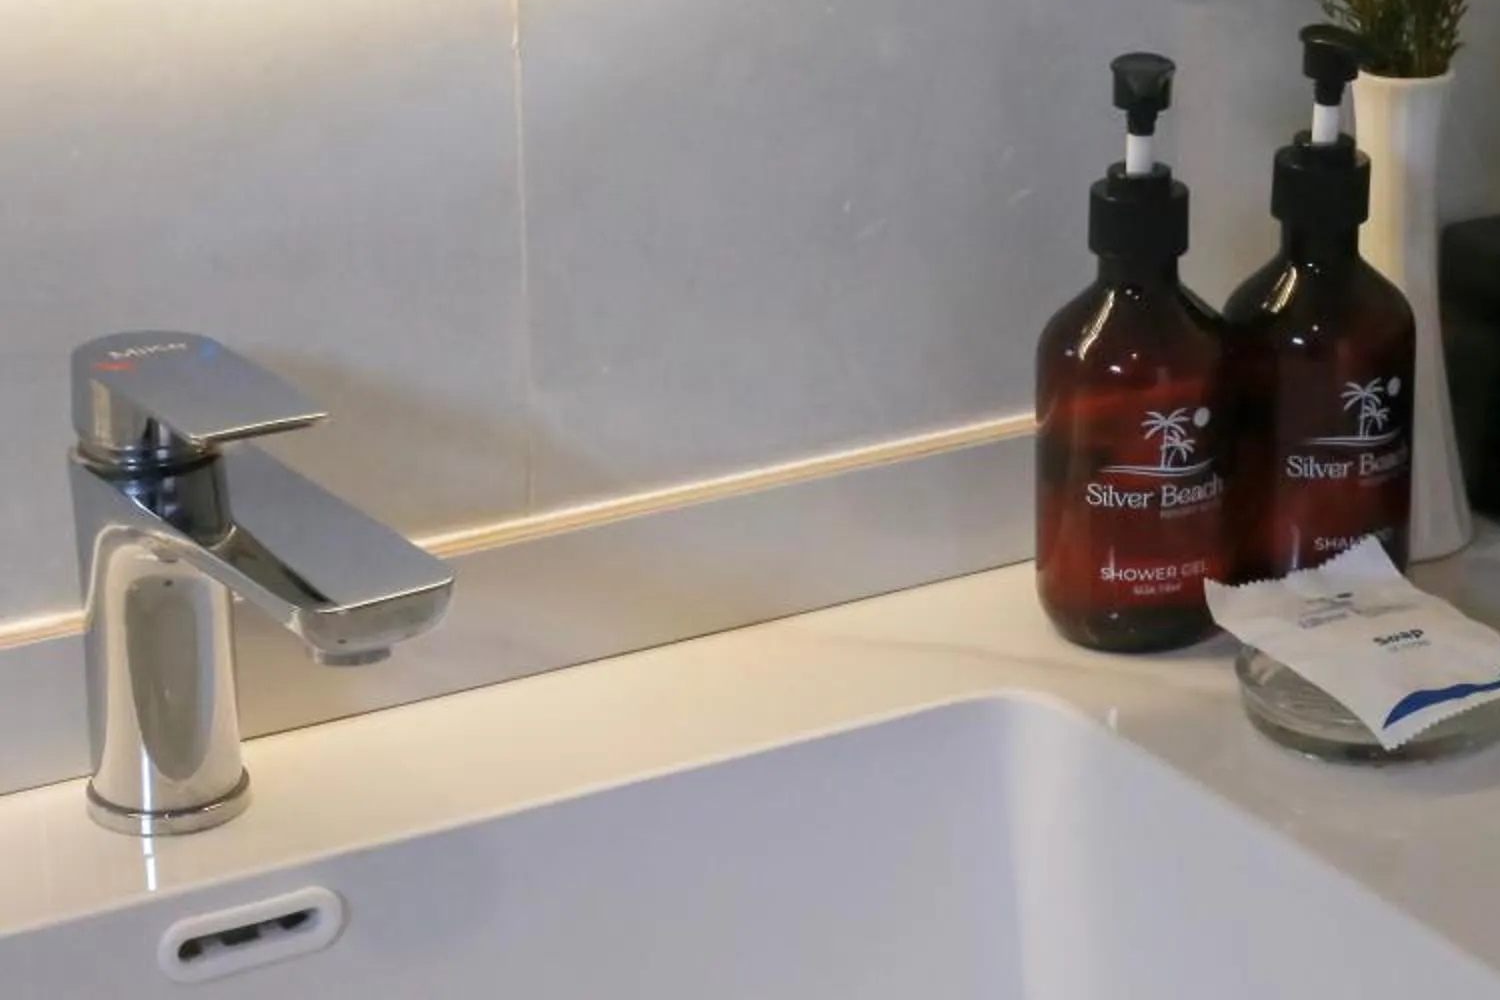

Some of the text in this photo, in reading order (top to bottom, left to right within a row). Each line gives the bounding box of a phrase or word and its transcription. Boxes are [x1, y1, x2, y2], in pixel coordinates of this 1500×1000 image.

[1286, 455, 1353, 478] Silver
[1086, 472, 1223, 508] Silver Beach
[1101, 566, 1177, 581] SHOWER
